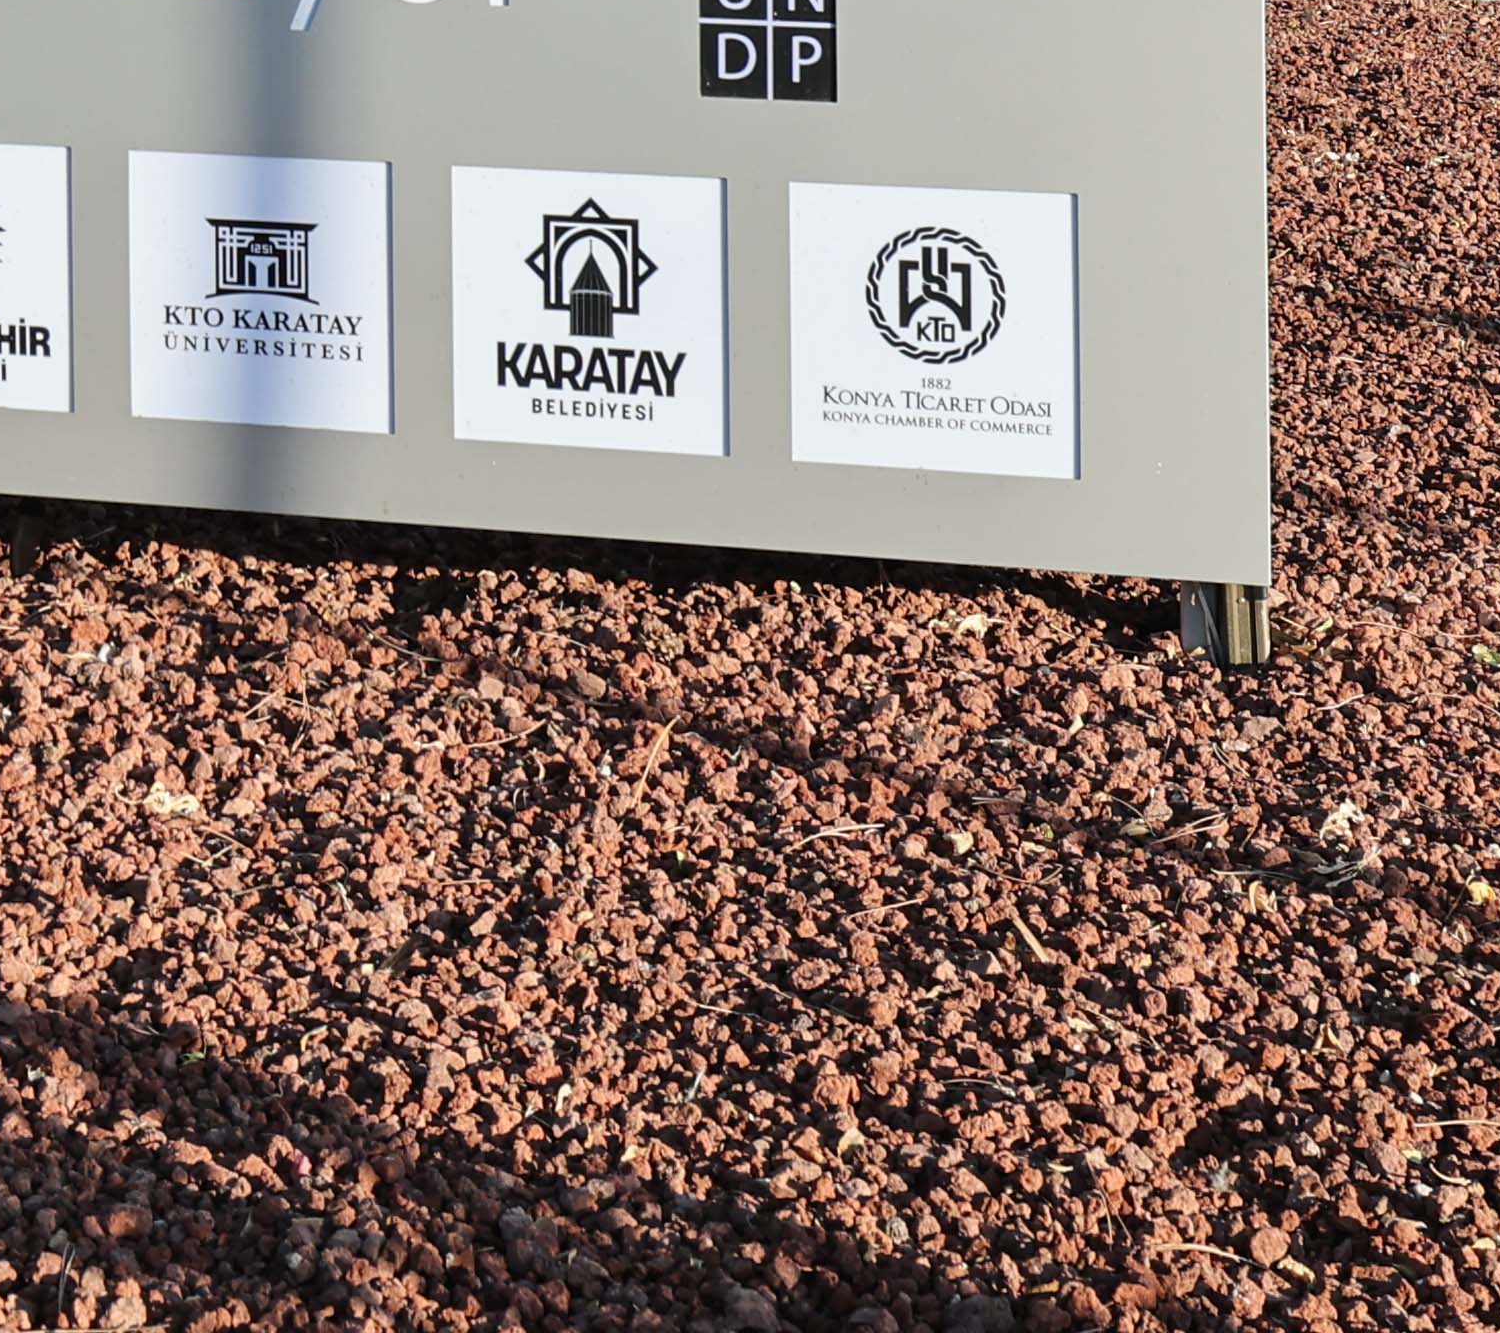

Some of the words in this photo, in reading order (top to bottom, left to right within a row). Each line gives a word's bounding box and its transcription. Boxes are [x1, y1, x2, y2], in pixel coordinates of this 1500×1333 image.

[250, 243, 273, 254] 1251
[164, 305, 224, 328] KTO
[232, 309, 363, 336] KARATAY
[917, 316, 955, 343] KTO
[164, 331, 364, 361] ÜNİVERSİTESİ
[497, 341, 687, 397] KARATAY
[921, 378, 952, 390] 1882
[532, 398, 653, 421] BELEDİYESİ
[823, 411, 871, 424] KONYA
[874, 413, 943, 430] CHAMBER
[947, 419, 966, 431] OF
[970, 420, 1053, 436] COMMERCE
